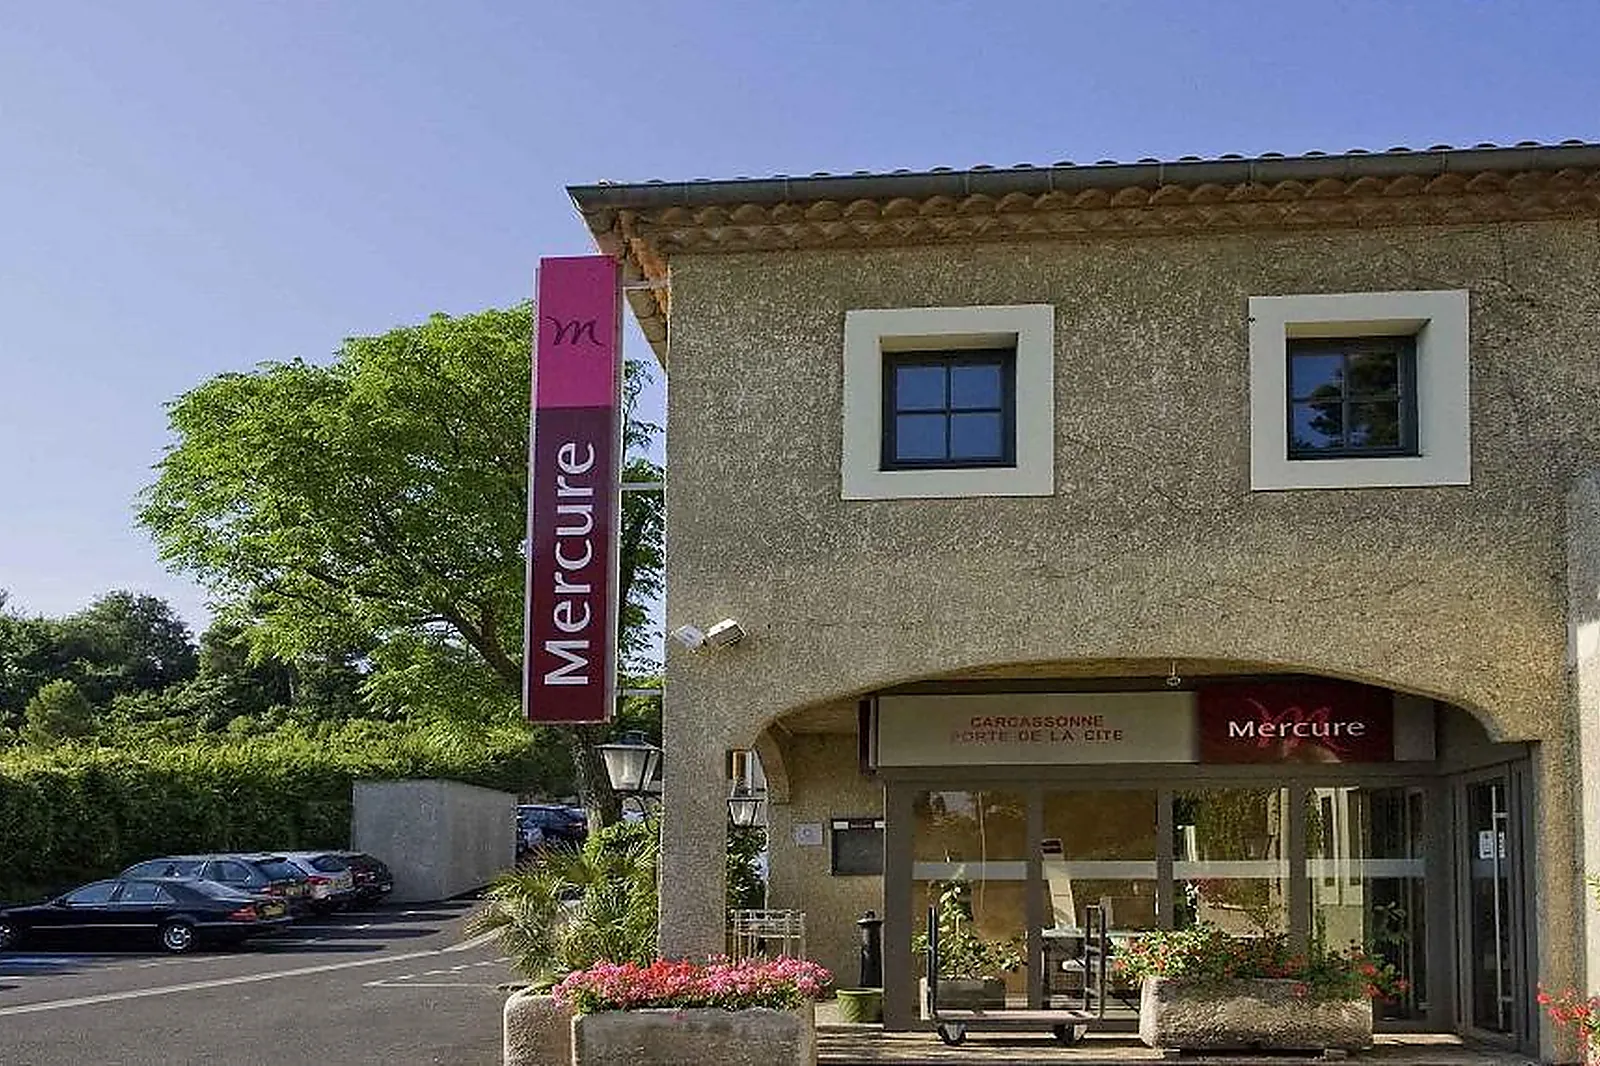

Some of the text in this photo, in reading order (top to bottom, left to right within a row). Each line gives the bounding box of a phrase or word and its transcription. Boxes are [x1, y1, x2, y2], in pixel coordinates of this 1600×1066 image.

[543, 442, 595, 685] Mercure
[971, 715, 1104, 728] CARCASSONNE
[1228, 720, 1366, 737] Mercure
[1018, 729, 1043, 742] DE
[1050, 729, 1075, 742] LA
